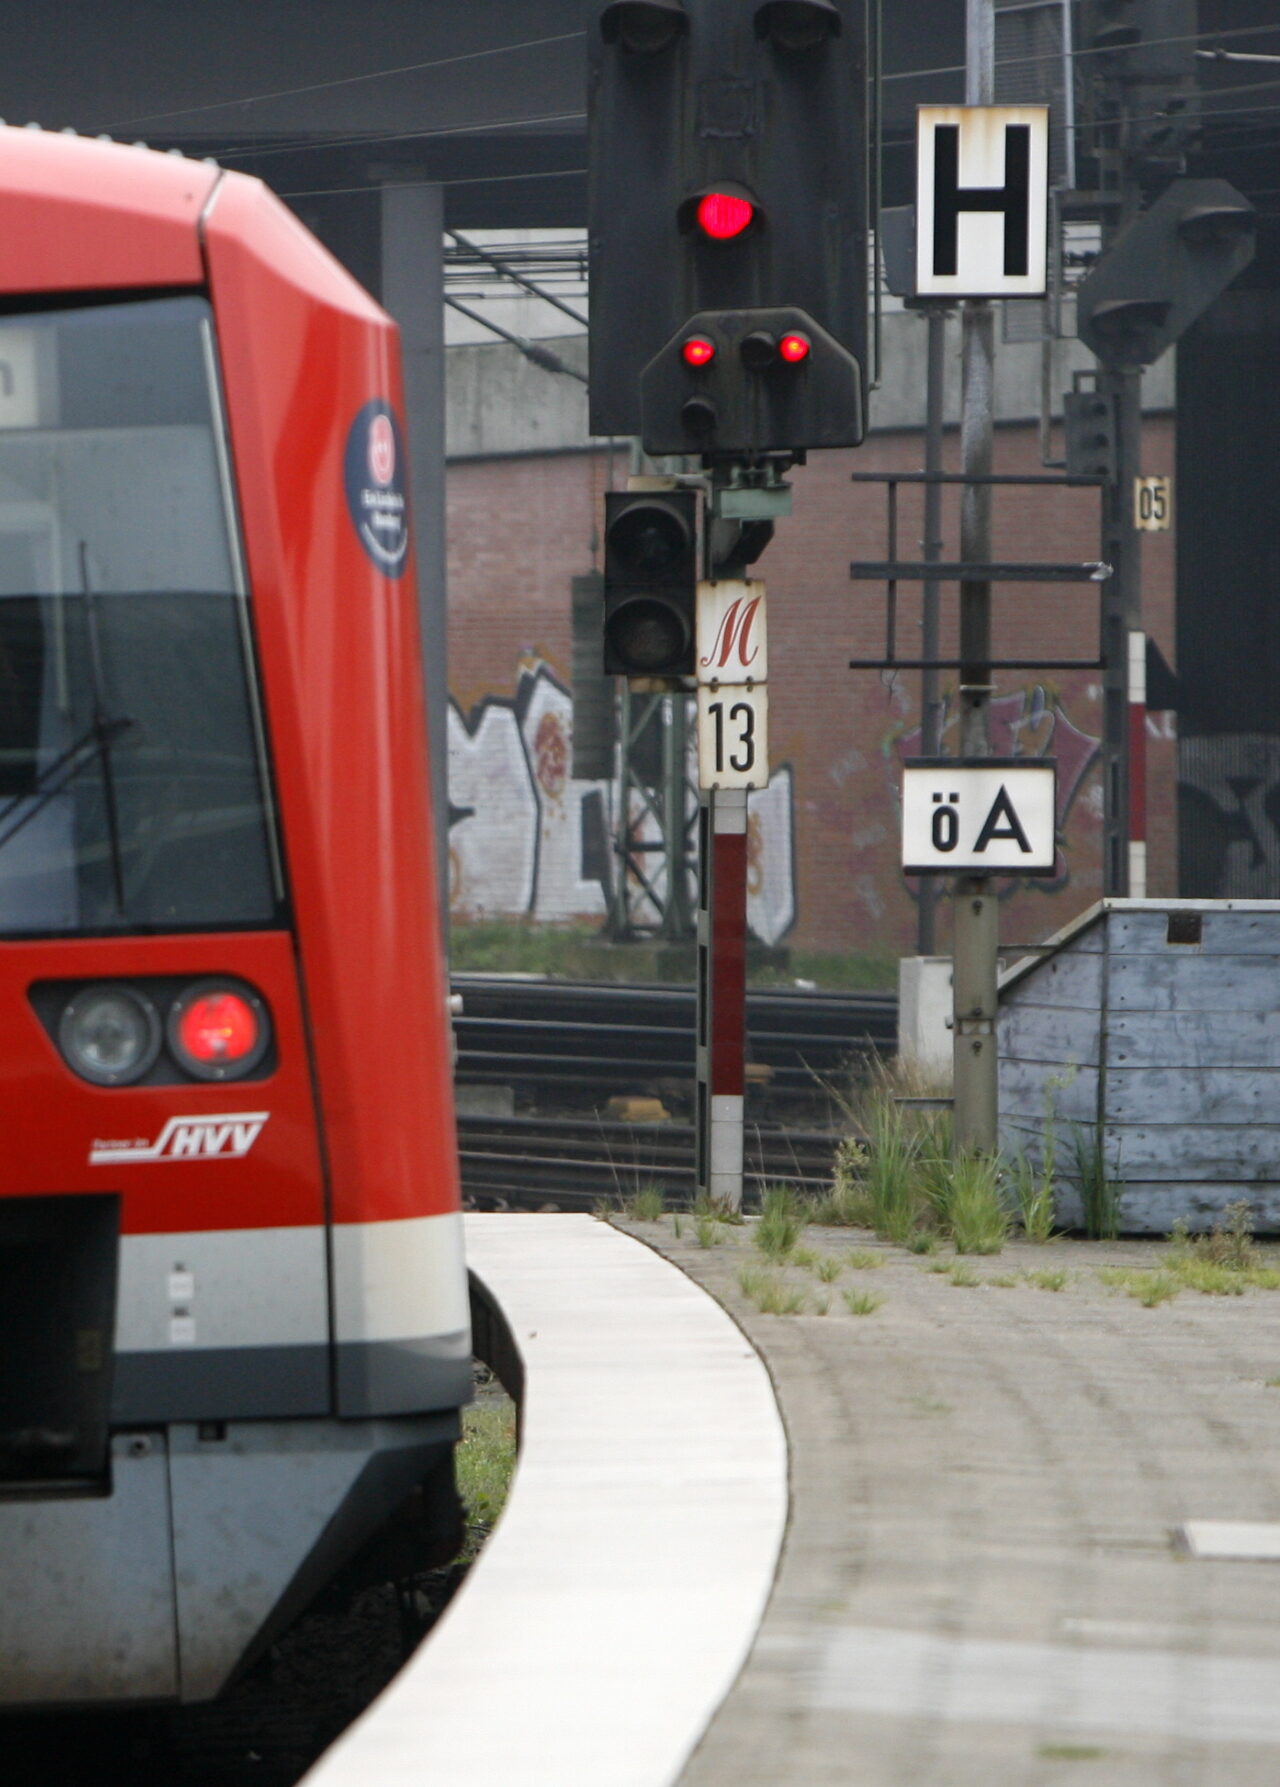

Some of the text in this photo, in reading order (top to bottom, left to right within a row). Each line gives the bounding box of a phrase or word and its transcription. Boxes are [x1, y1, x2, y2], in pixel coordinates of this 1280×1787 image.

[933, 124, 1031, 276] H
[1140, 486, 1166, 520] 05
[708, 702, 755, 773] 13
[172, 1121, 263, 1157] HVV
